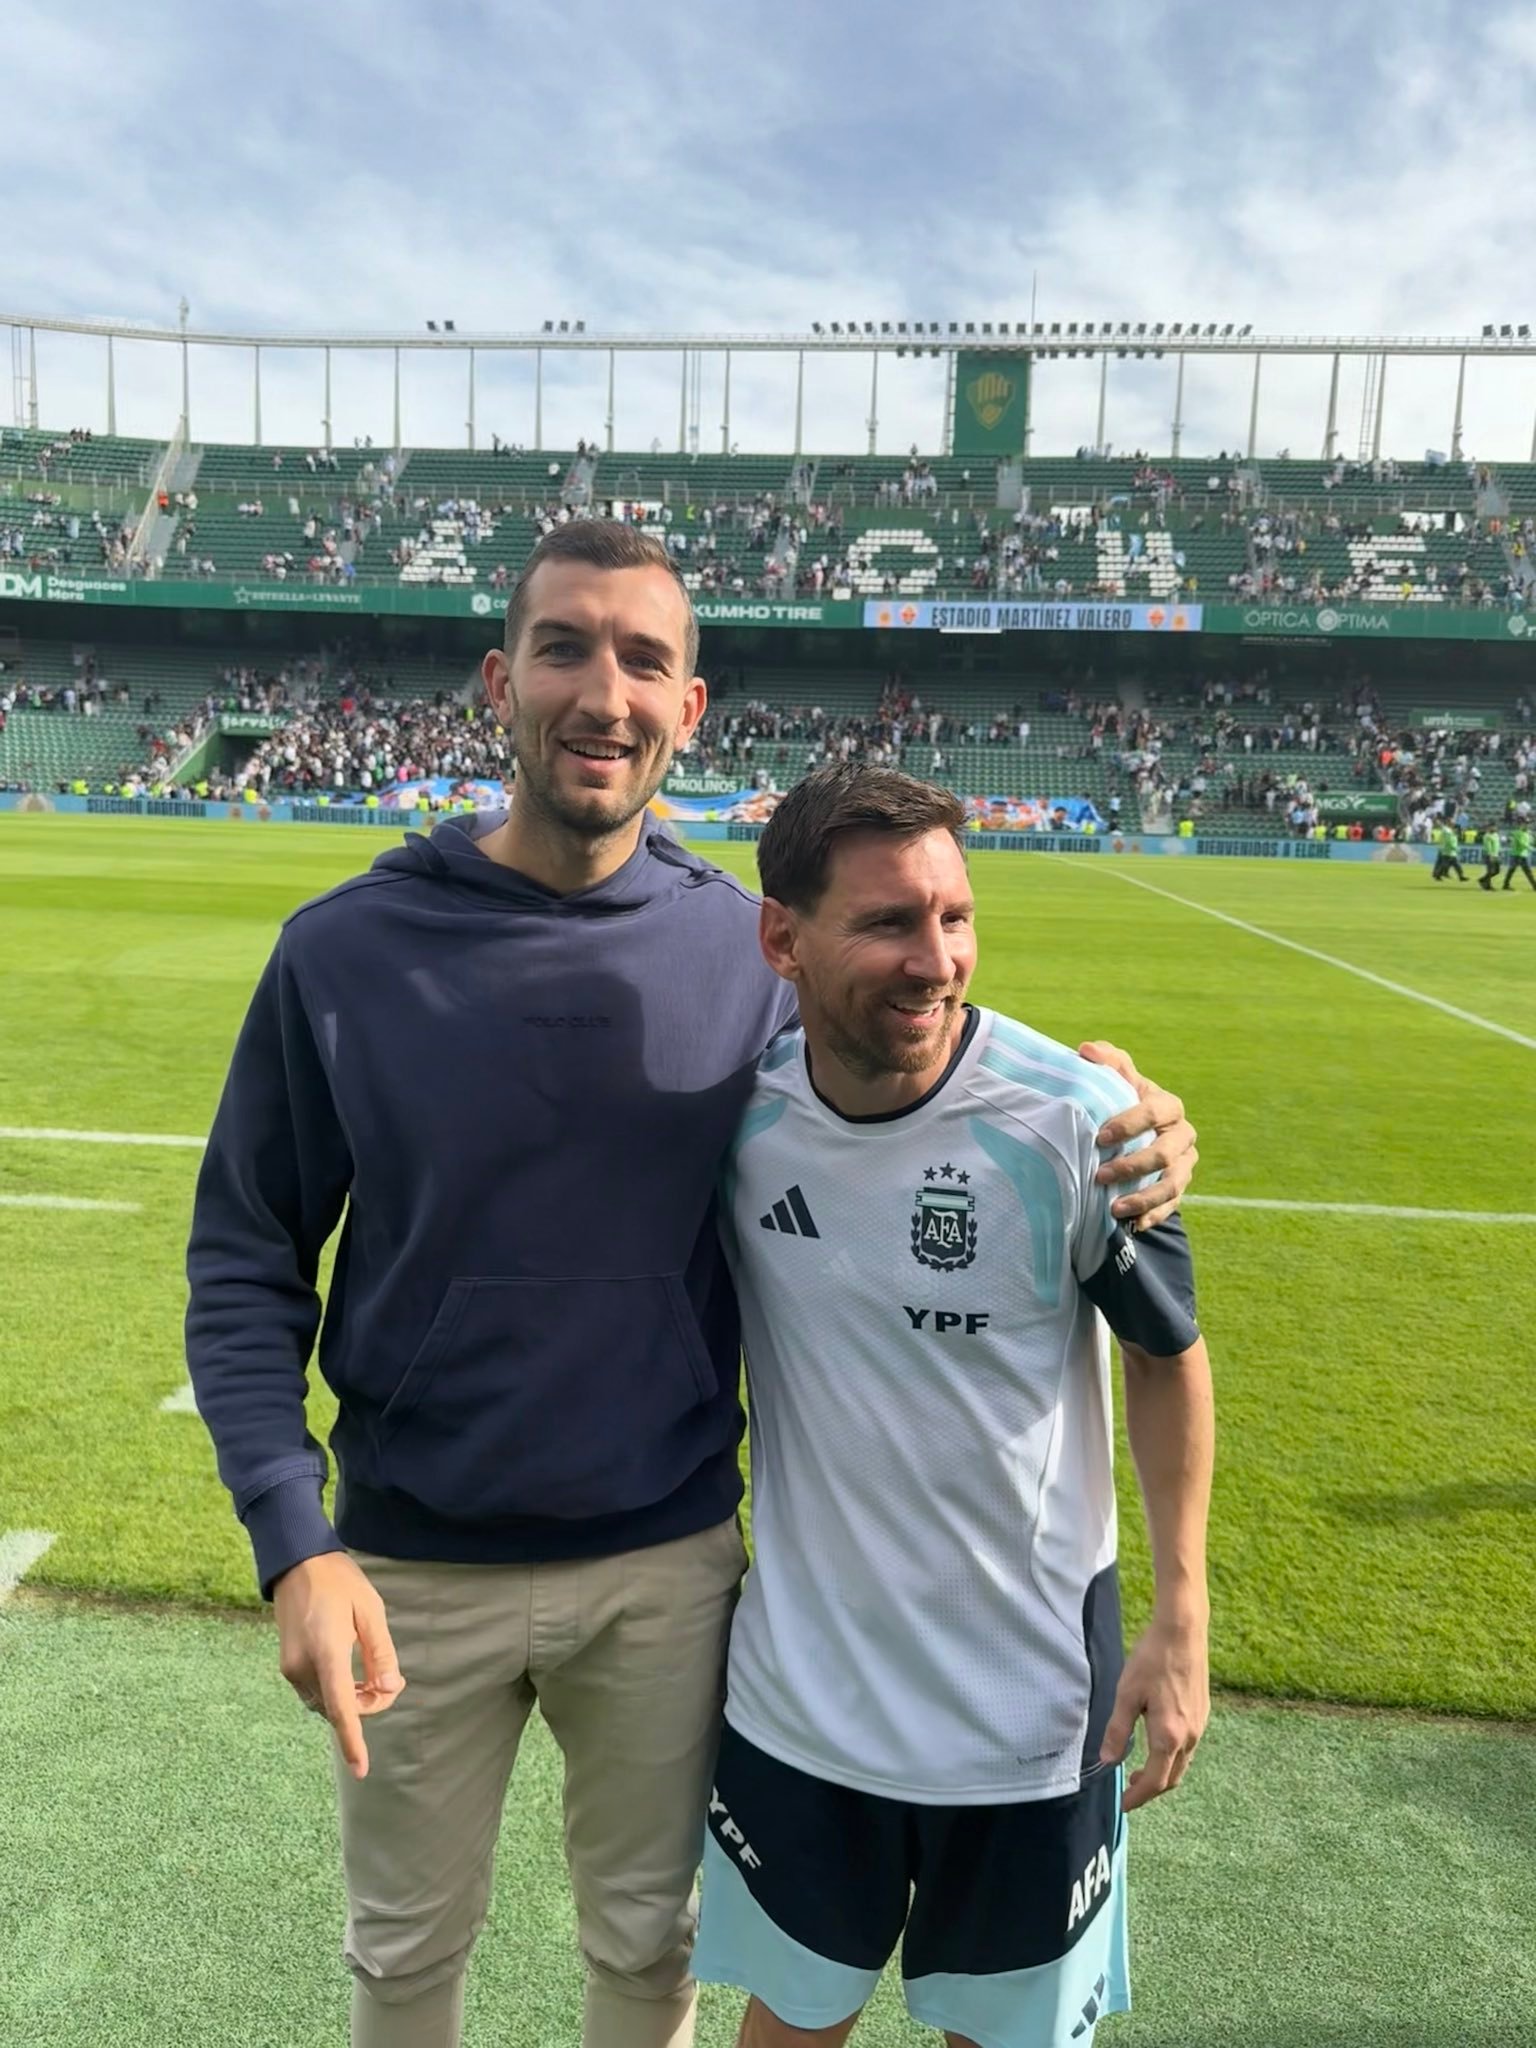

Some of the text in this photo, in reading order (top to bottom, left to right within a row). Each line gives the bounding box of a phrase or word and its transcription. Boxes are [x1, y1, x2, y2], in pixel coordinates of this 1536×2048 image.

[687, 605, 823, 620] KUMHO TIRE
[931, 607, 991, 627] ESTADIO
[1077, 609, 1132, 629] VALERO
[666, 778, 737, 793] PIKOLINOS
[1197, 840, 1278, 857] BIENVENIDOS
[1295, 843, 1331, 858] ELCHE
[923, 1208, 963, 1248] AFA
[902, 1305, 989, 1335] YPF
[709, 1784, 762, 1869] YPF
[1067, 1843, 1111, 1932] AFA
